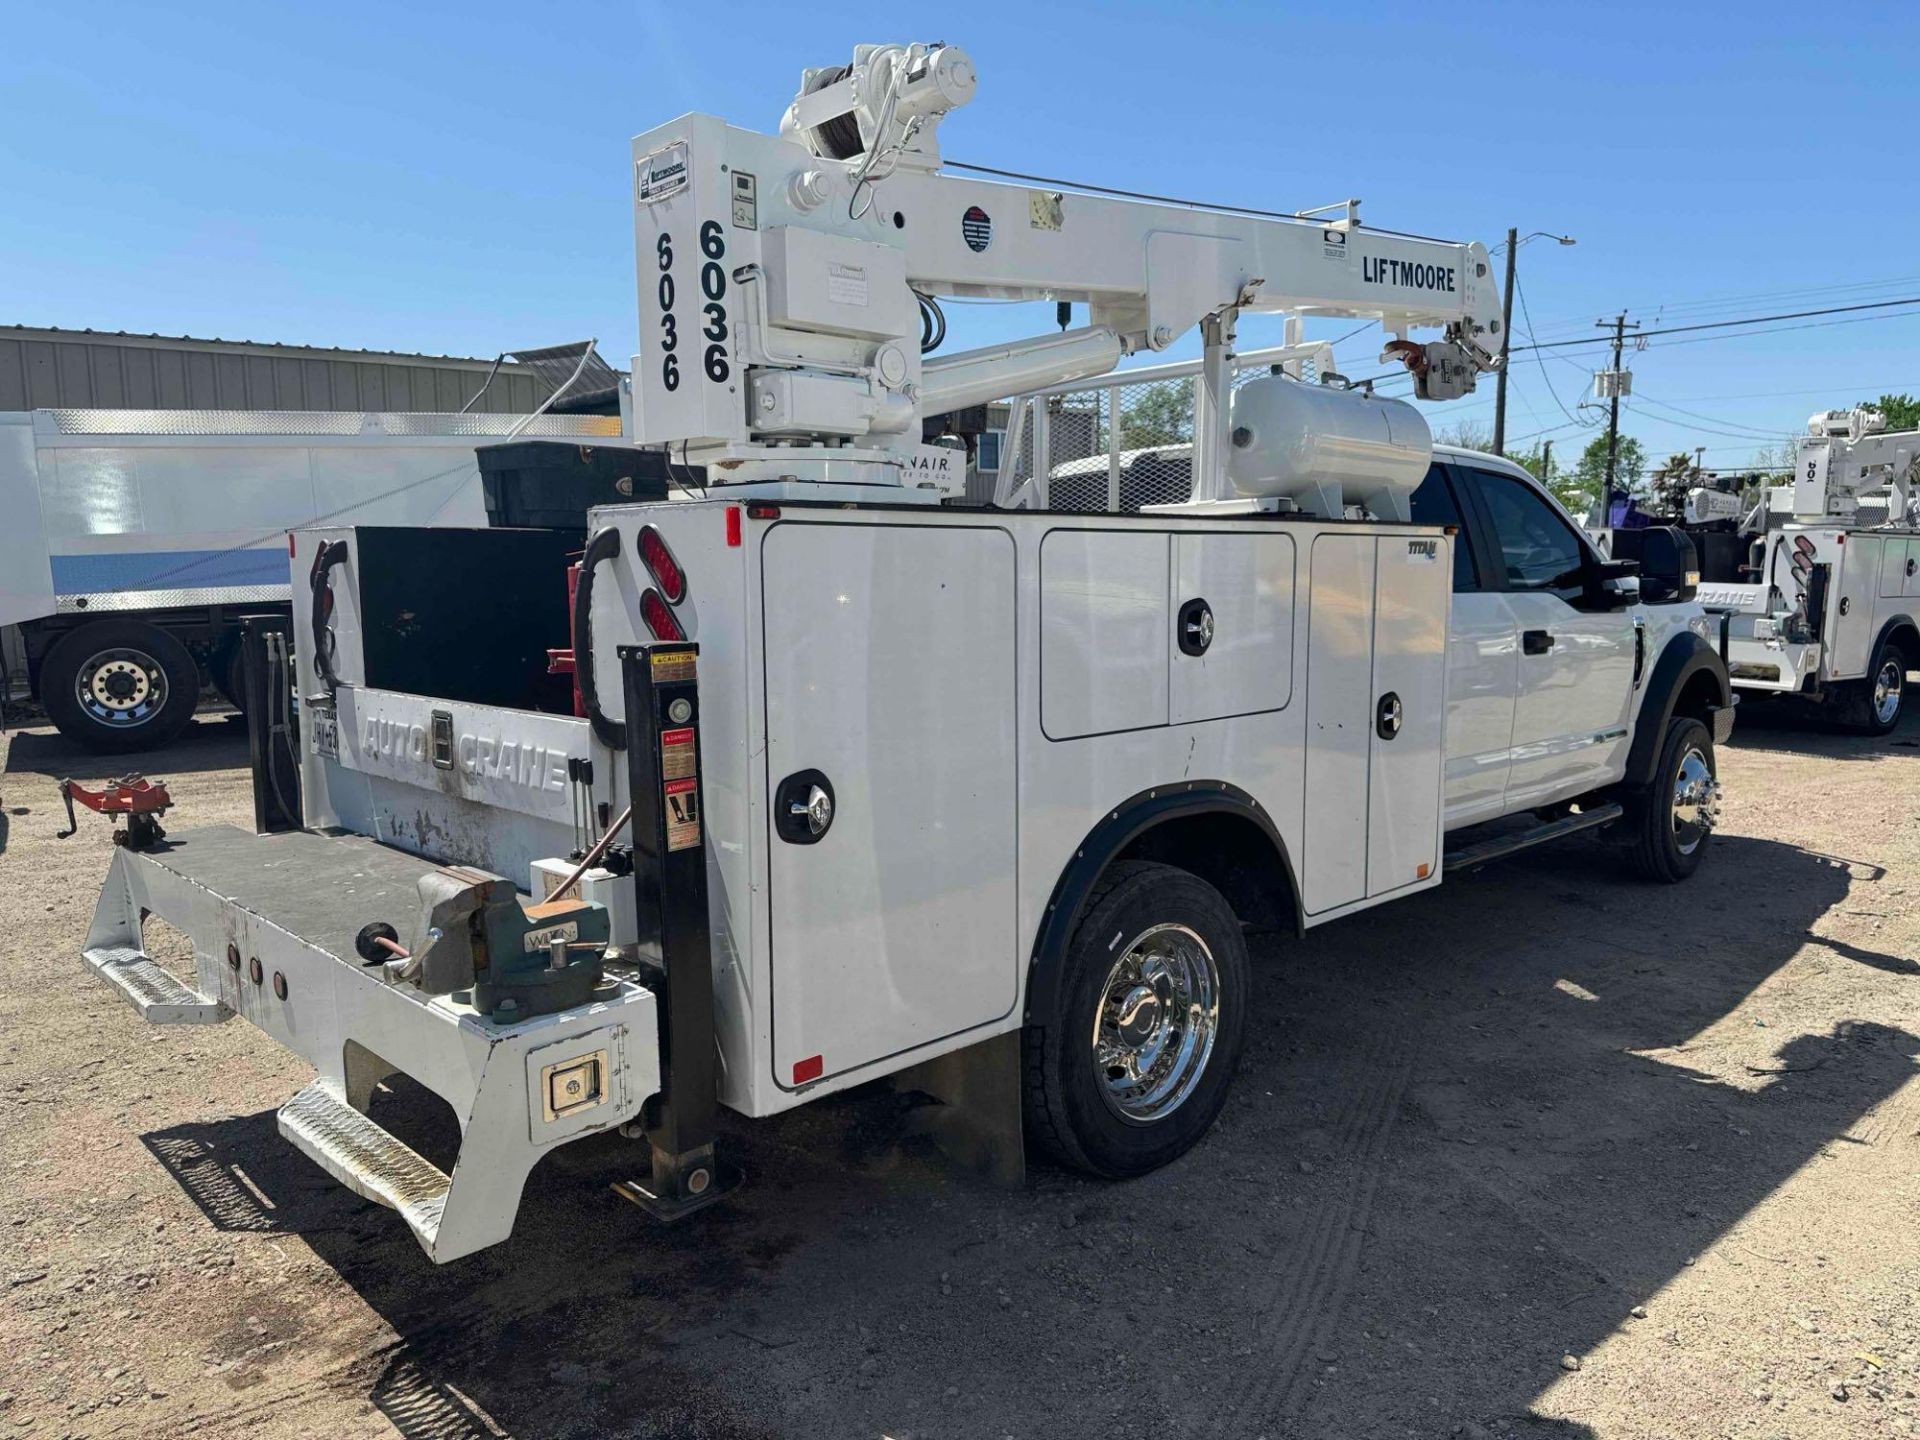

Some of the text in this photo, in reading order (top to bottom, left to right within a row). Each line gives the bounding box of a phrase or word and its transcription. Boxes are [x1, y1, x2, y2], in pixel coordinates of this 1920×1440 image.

[1363, 256, 1456, 292] LIFTMOORE
[657, 232, 680, 392] 6036
[700, 220, 730, 384] 6036
[1697, 590, 1757, 606] RANE
[662, 655, 692, 663] CAUTION
[363, 717, 568, 792] AUTO CRANE
